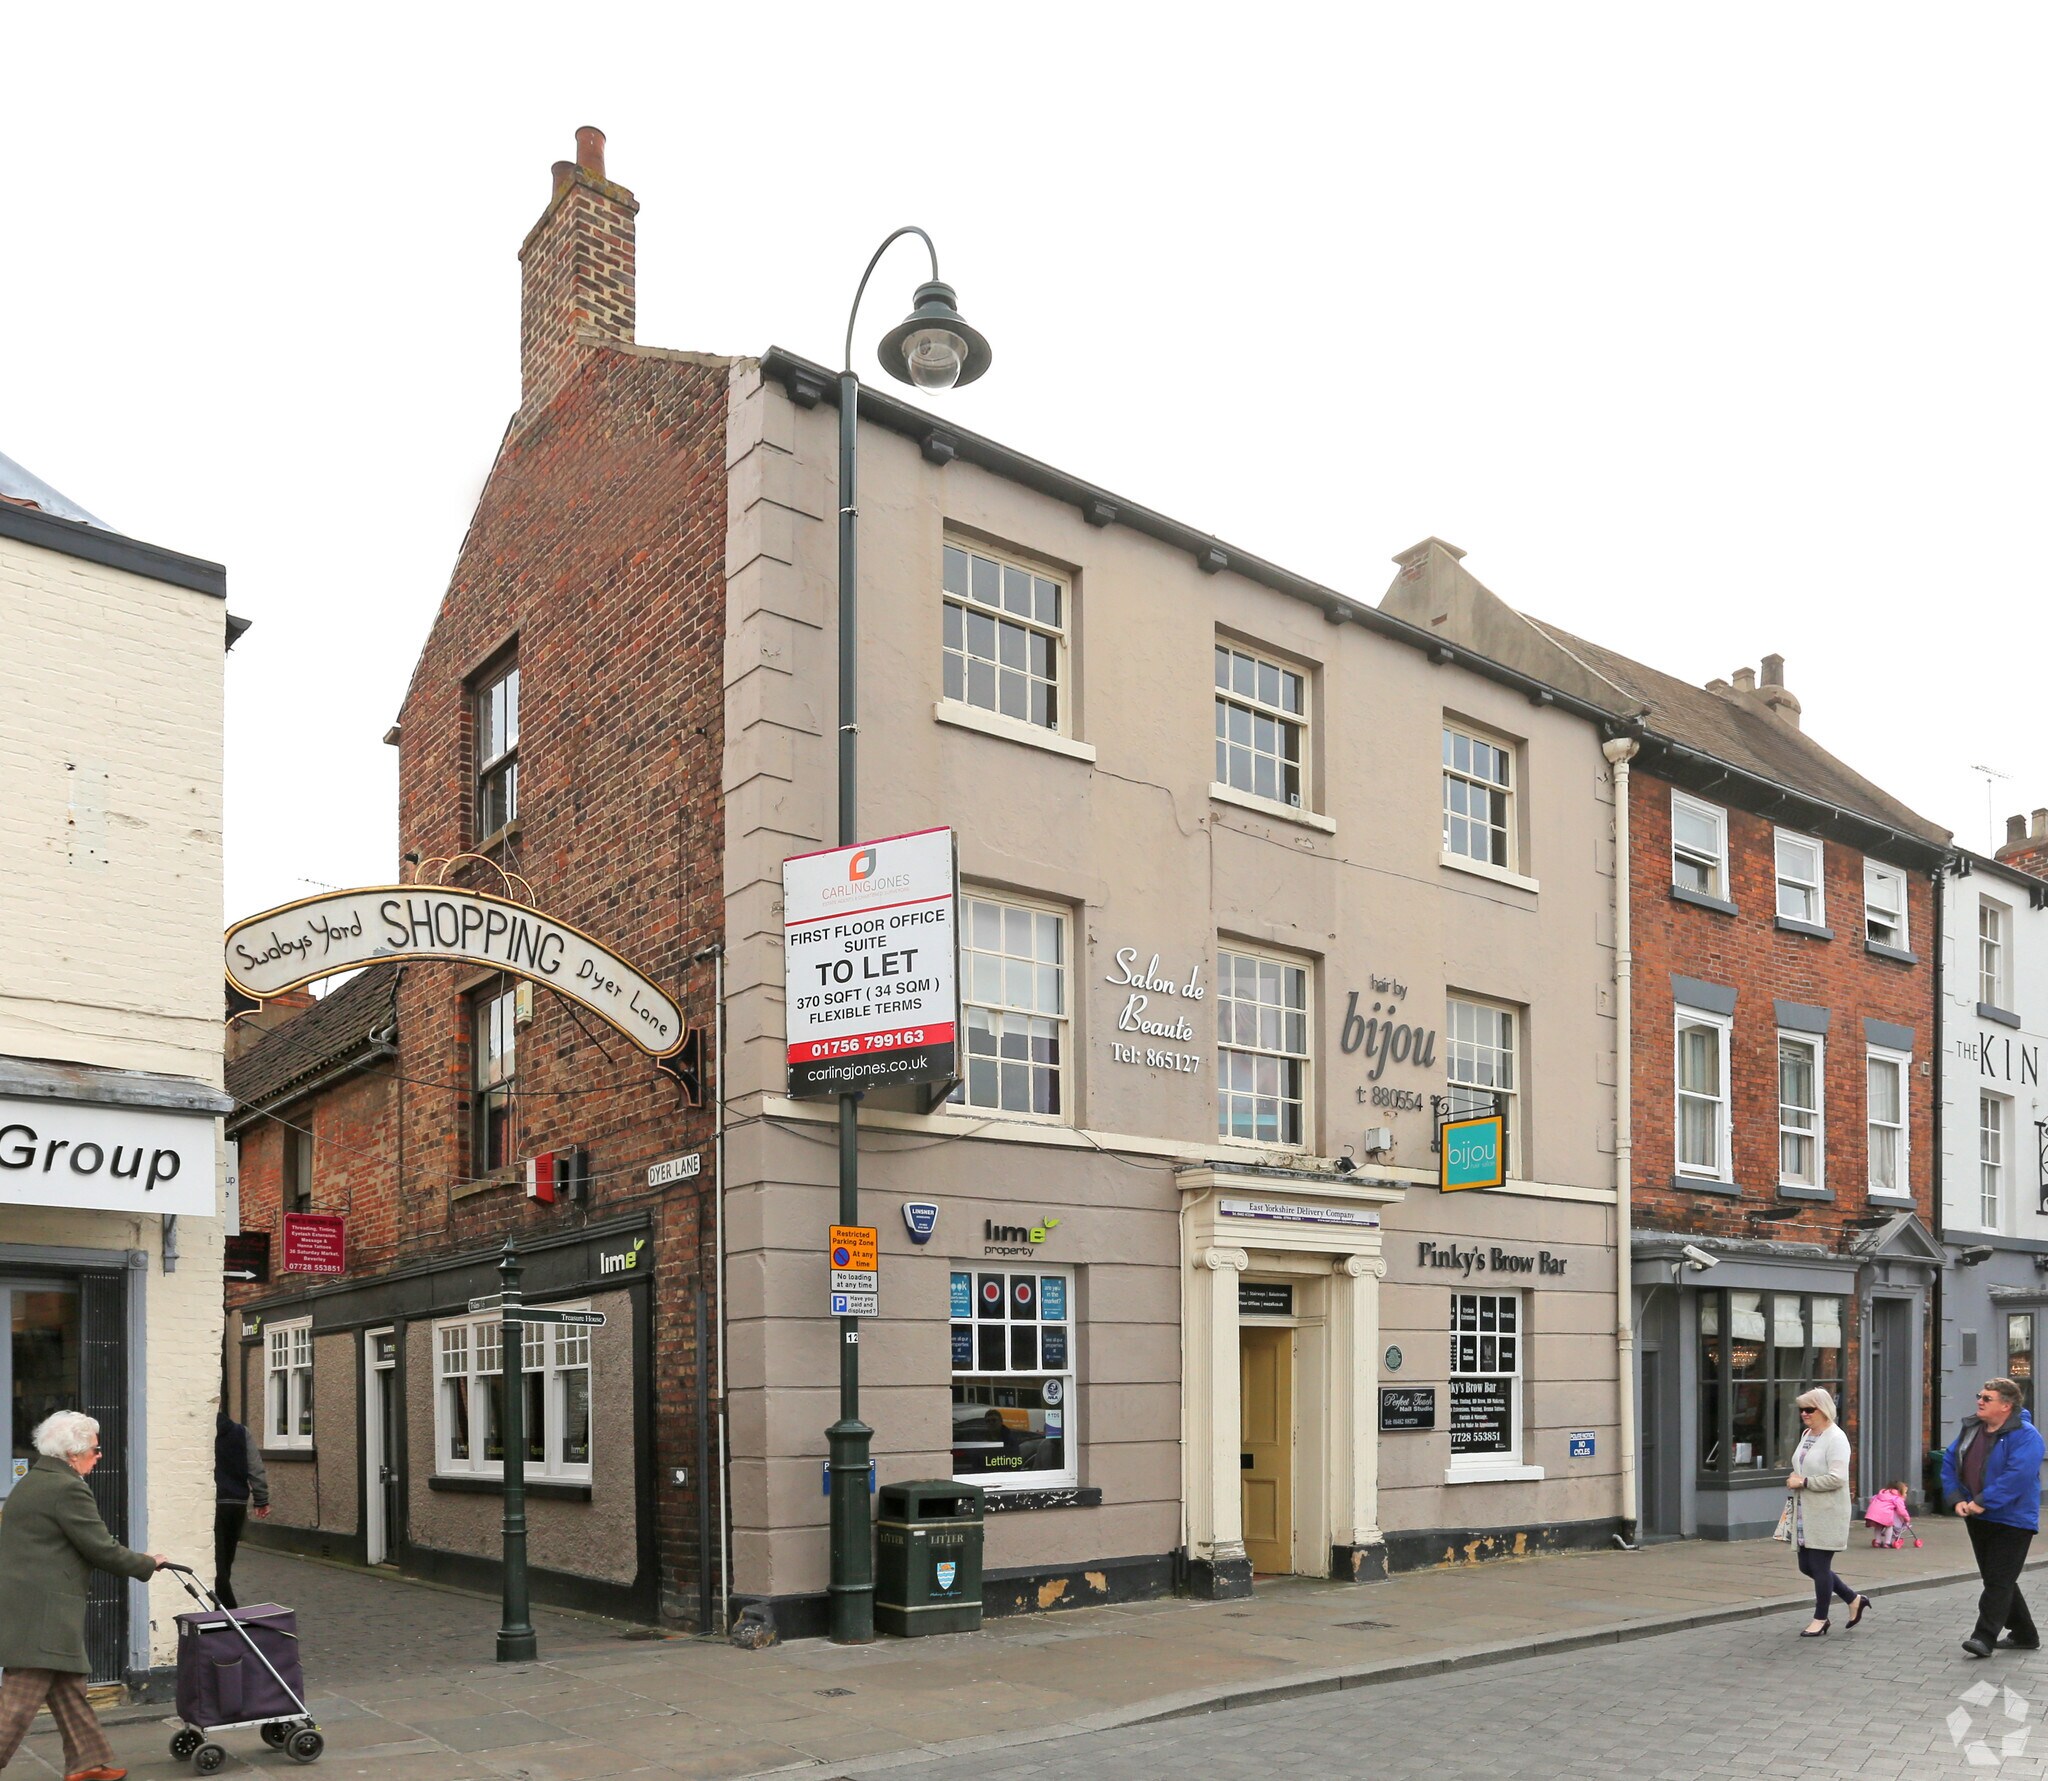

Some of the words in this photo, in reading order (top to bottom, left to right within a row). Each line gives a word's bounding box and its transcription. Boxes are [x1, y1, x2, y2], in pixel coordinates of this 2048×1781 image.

[822, 873, 910, 899] CARLINGJONES
[790, 927, 831, 947] FIRST
[834, 919, 885, 939] FLOOR
[889, 909, 945, 929] OFFICE
[844, 935, 887, 953] SUITE
[236, 931, 313, 971] Swabys
[308, 911, 362, 955] Yard
[380, 899, 565, 975] SHOPPING
[576, 958, 623, 998] Dyer
[629, 990, 668, 1036] Lane
[815, 959, 854, 986] TO
[863, 949, 919, 979] LET
[1105, 947, 1176, 995] Salon
[1181, 965, 1205, 1000] de
[796, 995, 820, 1010] 370
[824, 988, 862, 1005] SQFT
[875, 984, 891, 998] 34
[896, 978, 930, 995] SQM
[1370, 973, 1391, 993] hair
[1393, 978, 1408, 1001] by
[809, 1005, 871, 1024] FLEXIBLE
[875, 998, 922, 1015] TERMS
[811, 1038, 860, 1057] 01756
[864, 1029, 925, 1050] 799163
[1341, 991, 1436, 1080] bijou
[1111, 1042, 1141, 1064] Tel:
[1146, 1048, 1200, 1073] 865127
[1955, 1040, 1978, 1062] THE
[807, 1055, 928, 1082] carlingjones.co.uk
[1356, 1085, 1366, 1104] t:
[1372, 1085, 1423, 1112] 880554
[0, 1124, 181, 1191] Group
[1448, 1140, 1496, 1170] bijou
[649, 1163, 672, 1184] DYER
[675, 1155, 699, 1177] LANE
[1249, 1202, 1264, 1211] East
[1265, 1204, 1295, 1214] Yorkshire
[1296, 1206, 1325, 1218] Delivery
[1325, 1209, 1355, 1221] Company
[832, 1238, 857, 1246] Parking
[836, 1230, 870, 1238] Restricted
[985, 1218, 1047, 1243] lime
[600, 1251, 637, 1274] lime
[984, 1245, 1034, 1258] property
[1418, 1241, 1485, 1278] Pinky's
[1490, 1247, 1535, 1274] Brow
[1538, 1250, 1567, 1276] Bar
[314, 1264, 341, 1272] 553851
[848, 1273, 872, 1282] loading
[858, 1281, 872, 1289] time
[561, 1313, 584, 1321] Treasure
[585, 1315, 602, 1323] House
[1465, 1381, 1483, 1393] Brow
[1484, 1381, 1497, 1393] Bar
[1473, 1431, 1500, 1442] 553851
[985, 1455, 1022, 1467] Lettings
[1573, 1447, 1591, 1456] CYCLES
[880, 1533, 904, 1545] LITTER
[930, 1533, 964, 1545] LITTER
